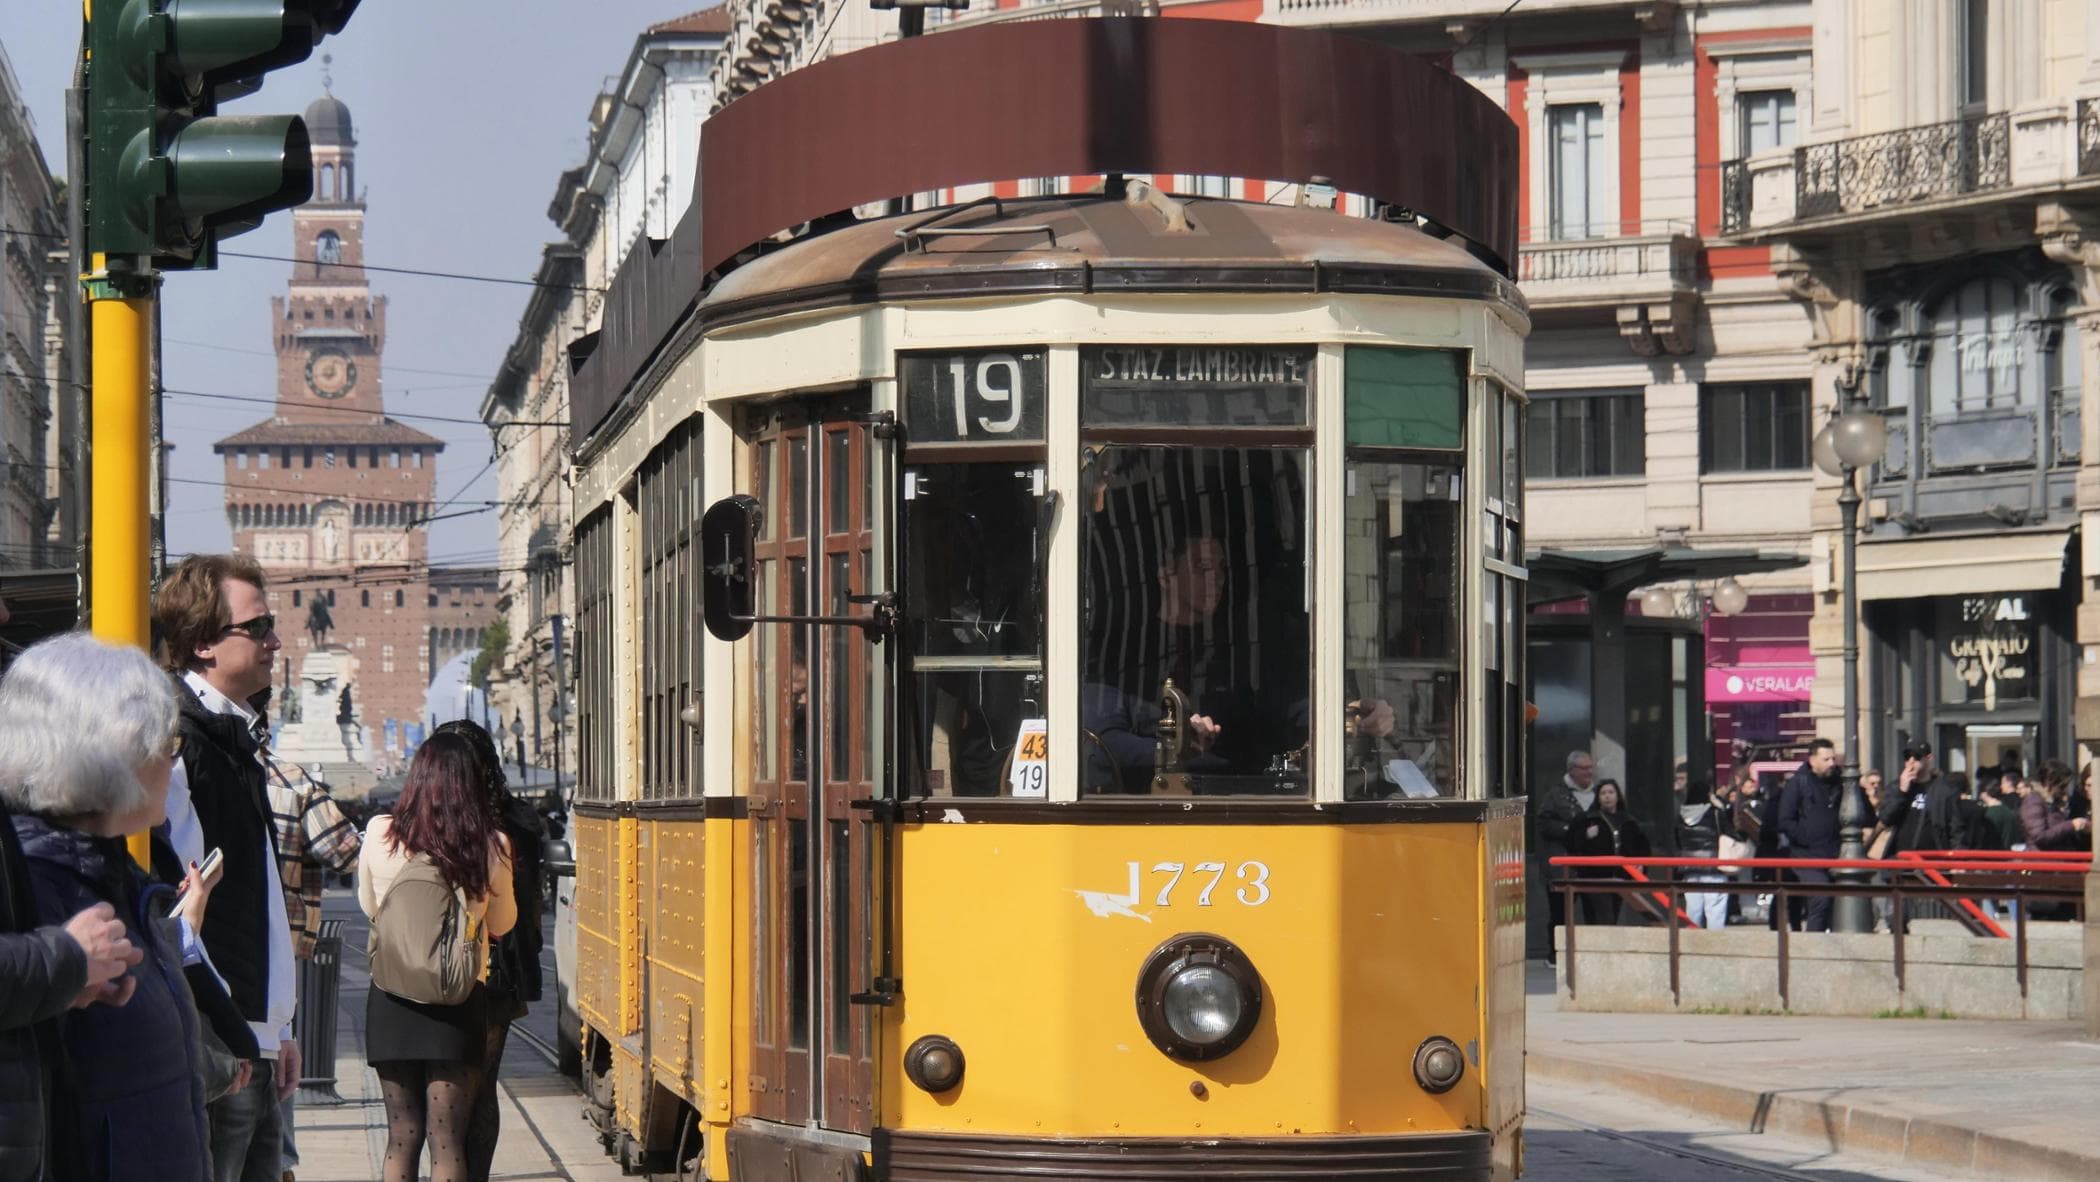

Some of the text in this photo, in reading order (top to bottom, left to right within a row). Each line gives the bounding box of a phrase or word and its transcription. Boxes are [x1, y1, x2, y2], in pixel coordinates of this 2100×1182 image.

[1100, 350, 1304, 383] STAZ. LAMBRATE
[949, 354, 1022, 436] 19
[1022, 735, 1047, 759] 43
[1019, 765, 1042, 790] 19
[1126, 861, 1271, 907] 1773
